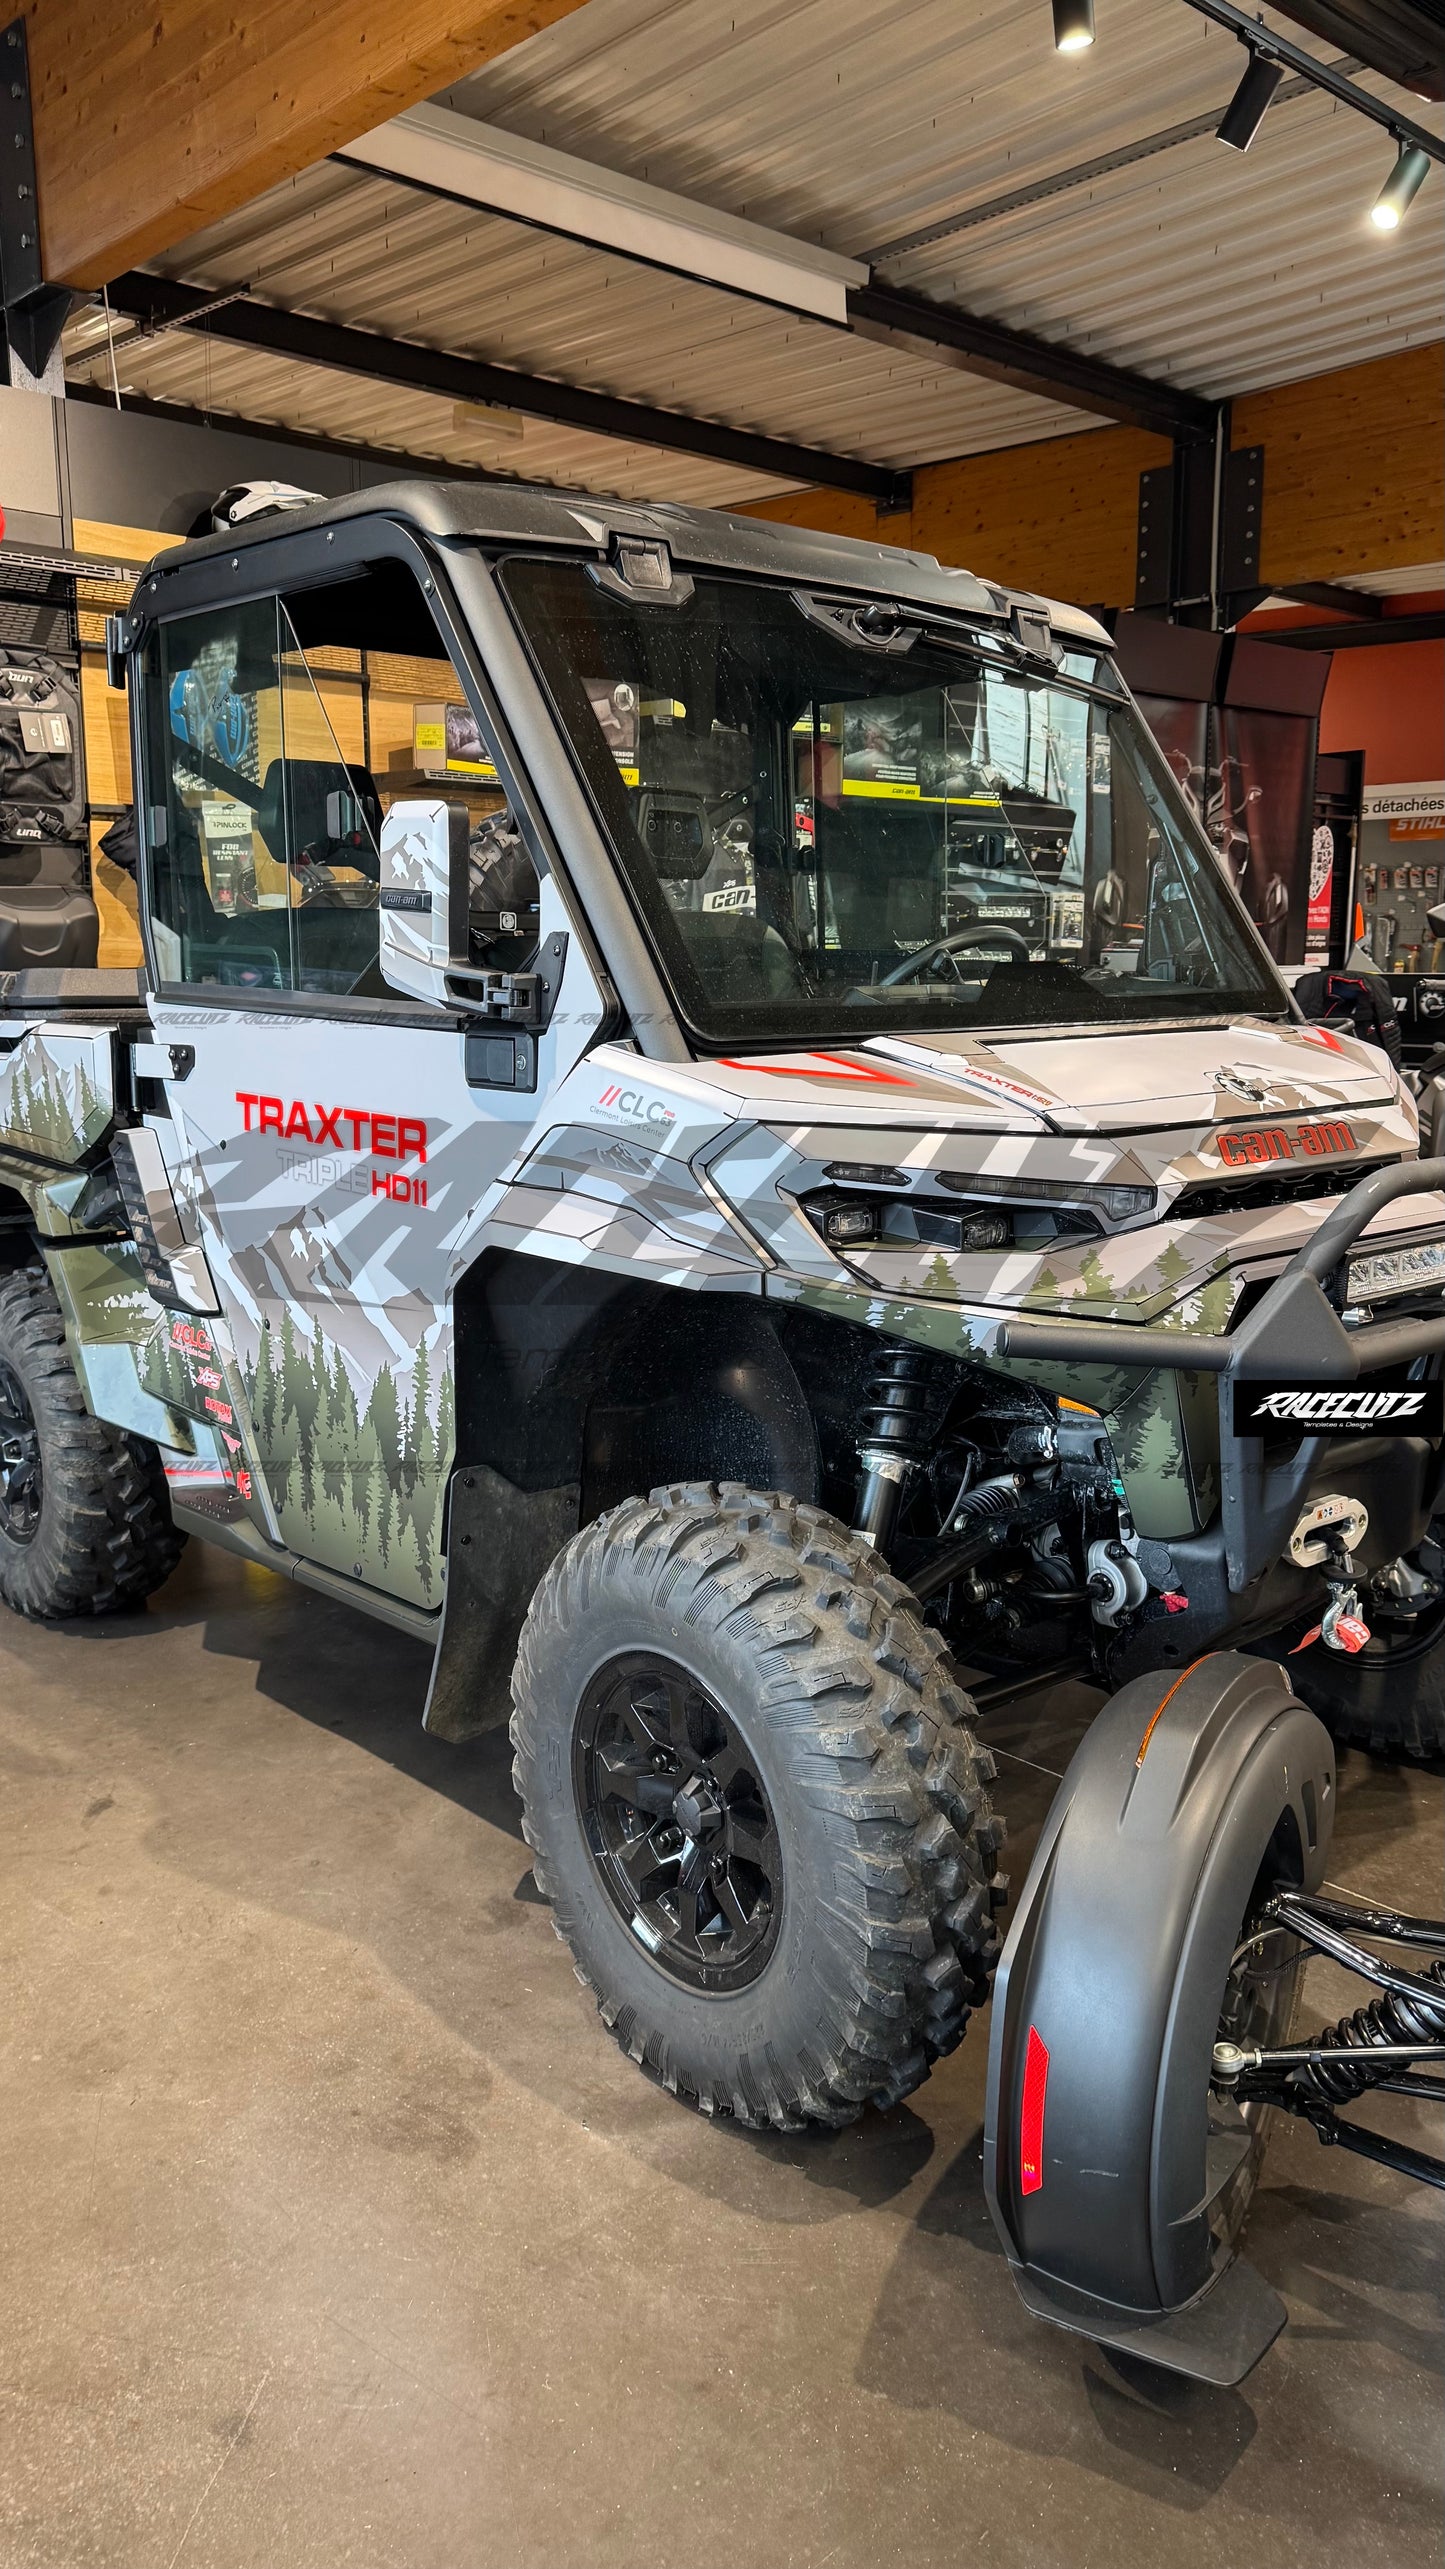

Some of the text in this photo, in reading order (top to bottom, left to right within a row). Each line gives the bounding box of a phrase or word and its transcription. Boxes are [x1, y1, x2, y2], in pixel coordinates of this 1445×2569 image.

[1372, 797, 1445, 814] détachées
[1396, 816, 1445, 831] STIHL
[711, 889, 756, 910] can-
[964, 1067, 1034, 1098] TRAXTER
[235, 1090, 428, 1164] TRAXTER
[589, 1105, 619, 1121] Clermont
[642, 1124, 666, 1138] Center
[1217, 1120, 1358, 1167] can-am
[276, 1148, 428, 1208] TRIPLE HD11
